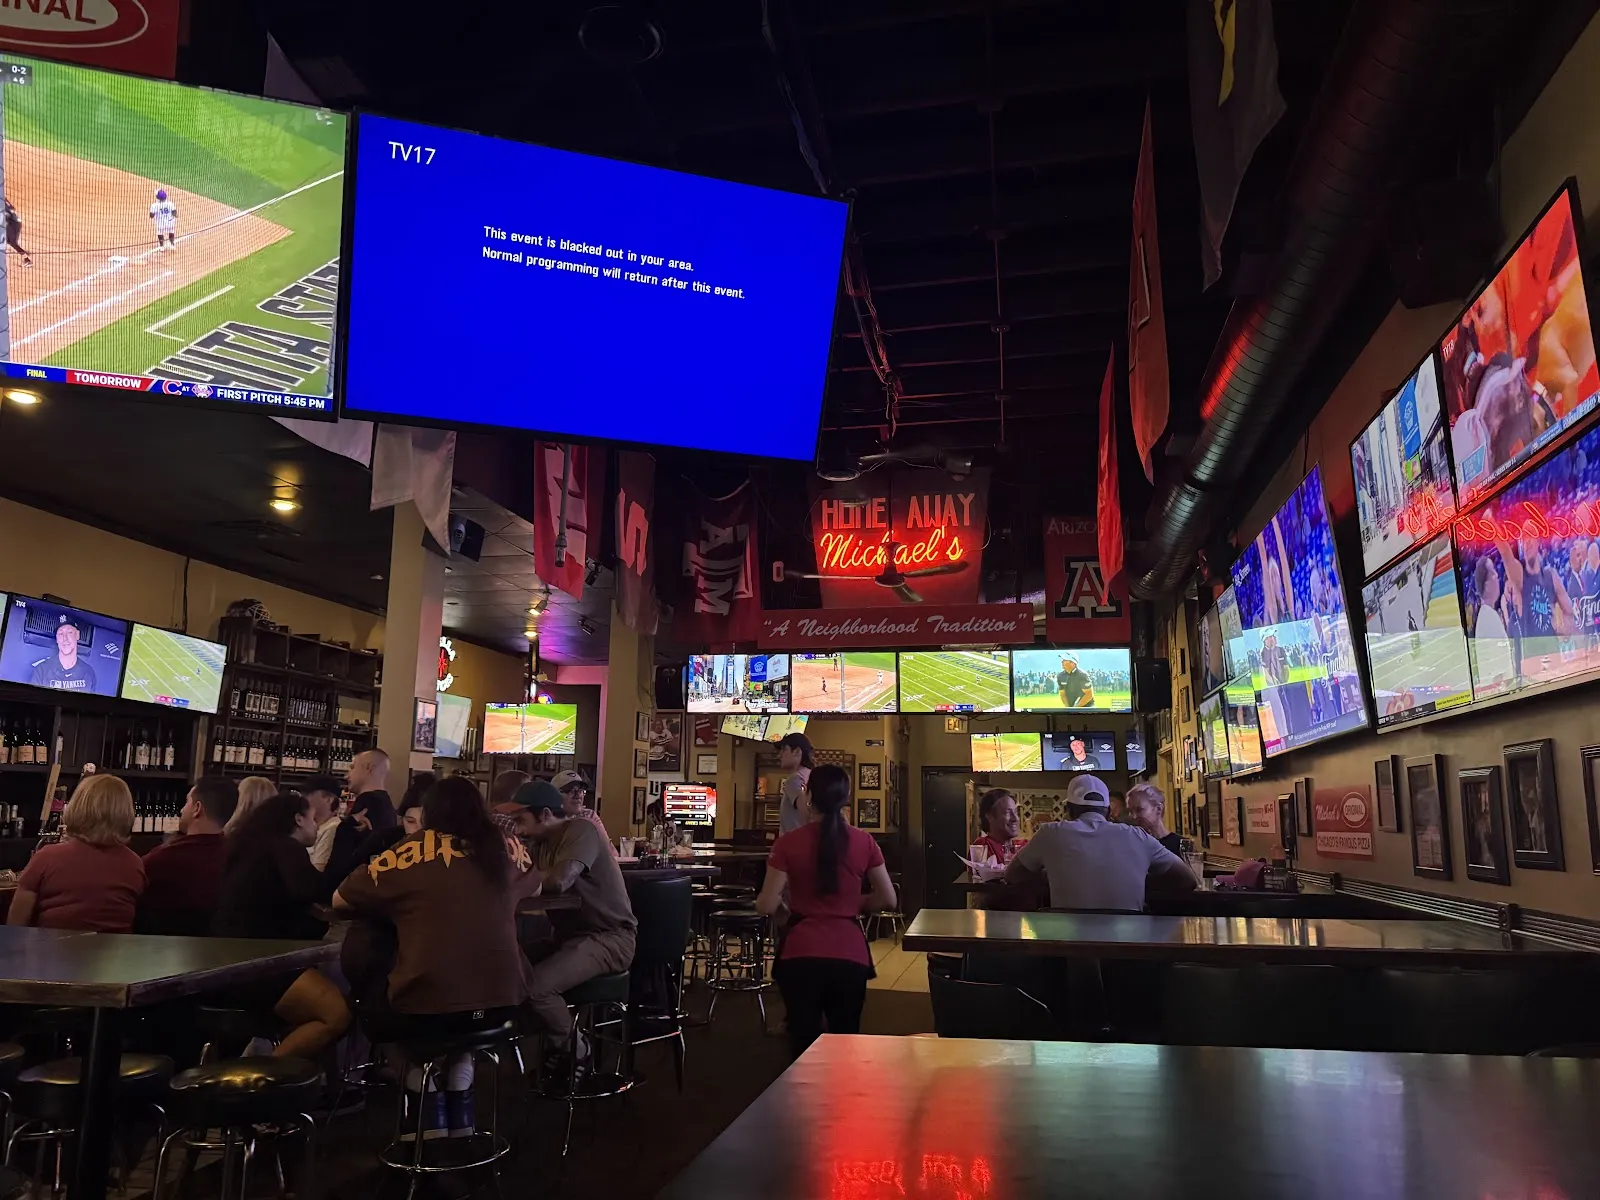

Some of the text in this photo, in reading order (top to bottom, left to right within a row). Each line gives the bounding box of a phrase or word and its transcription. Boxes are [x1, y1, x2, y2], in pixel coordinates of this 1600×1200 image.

[11, 65, 27, 75] 0-2
[388, 141, 436, 165] TV17
[484, 225, 694, 272] This event is blacked out in your area.
[482, 246, 746, 300] Normal programming will return after this event.
[26, 369, 48, 379] FINAL
[74, 372, 142, 389] TOMORROW
[181, 385, 190, 393] AT
[216, 388, 249, 402] FIRST
[250, 391, 282, 404] PITCH
[284, 395, 307, 407] 5:45
[308, 398, 325, 409] PM
[821, 492, 975, 530] HOME AWAY
[1046, 517, 1098, 536] ARIZO
[15, 600, 26, 608] TV4
[797, 618, 920, 639] Neighborhood
[62, 679, 87, 689] YANKEES
[947, 718, 964, 731] EXIT
[1356, 838, 1371, 850] PIZZA
